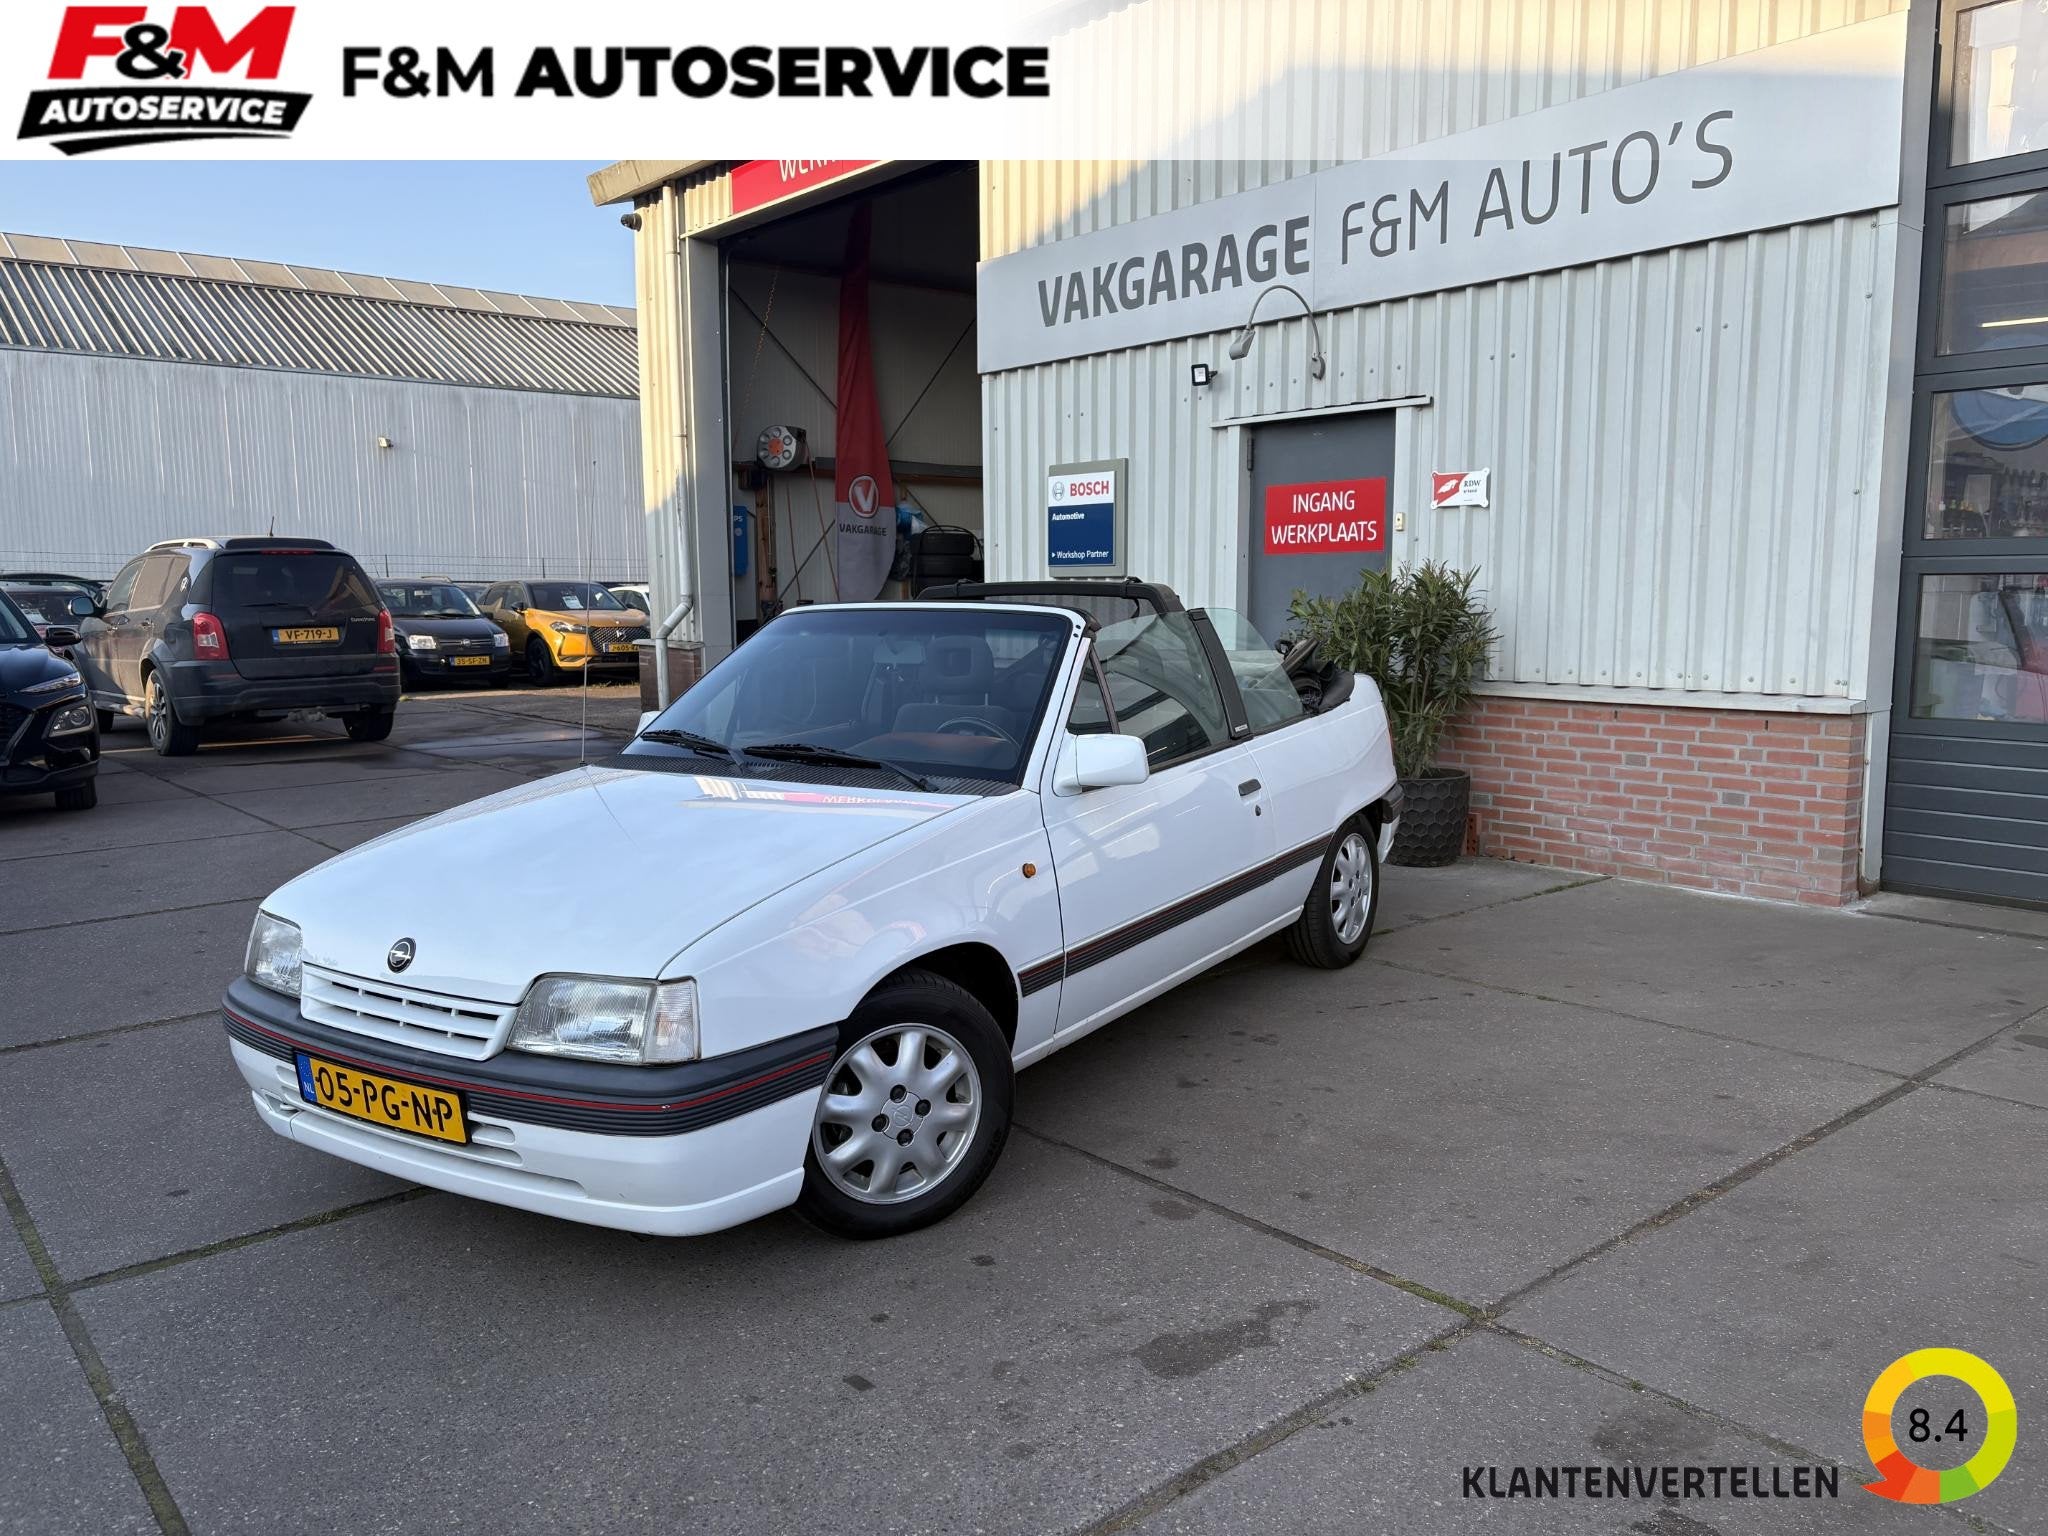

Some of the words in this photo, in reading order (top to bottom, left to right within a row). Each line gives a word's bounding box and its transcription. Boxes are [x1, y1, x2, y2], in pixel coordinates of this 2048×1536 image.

[1038, 215, 1310, 327] VAKGARAGE
[1341, 180, 1450, 265] F&M
[1473, 110, 1734, 238] AUTO'S
[1070, 480, 1110, 497] BOSCH
[1292, 490, 1356, 513] INGANG
[1052, 511, 1085, 521] Automotive
[839, 523, 888, 537] VAKGARAGE
[1271, 520, 1377, 545] WERKPLAATS
[1056, 550, 1086, 560] Workshop
[1086, 550, 1109, 558] Partner
[285, 629, 333, 640] VF-719-J
[303, 1081, 315, 1094] NL
[316, 1065, 454, 1133] 05-PG-NP
